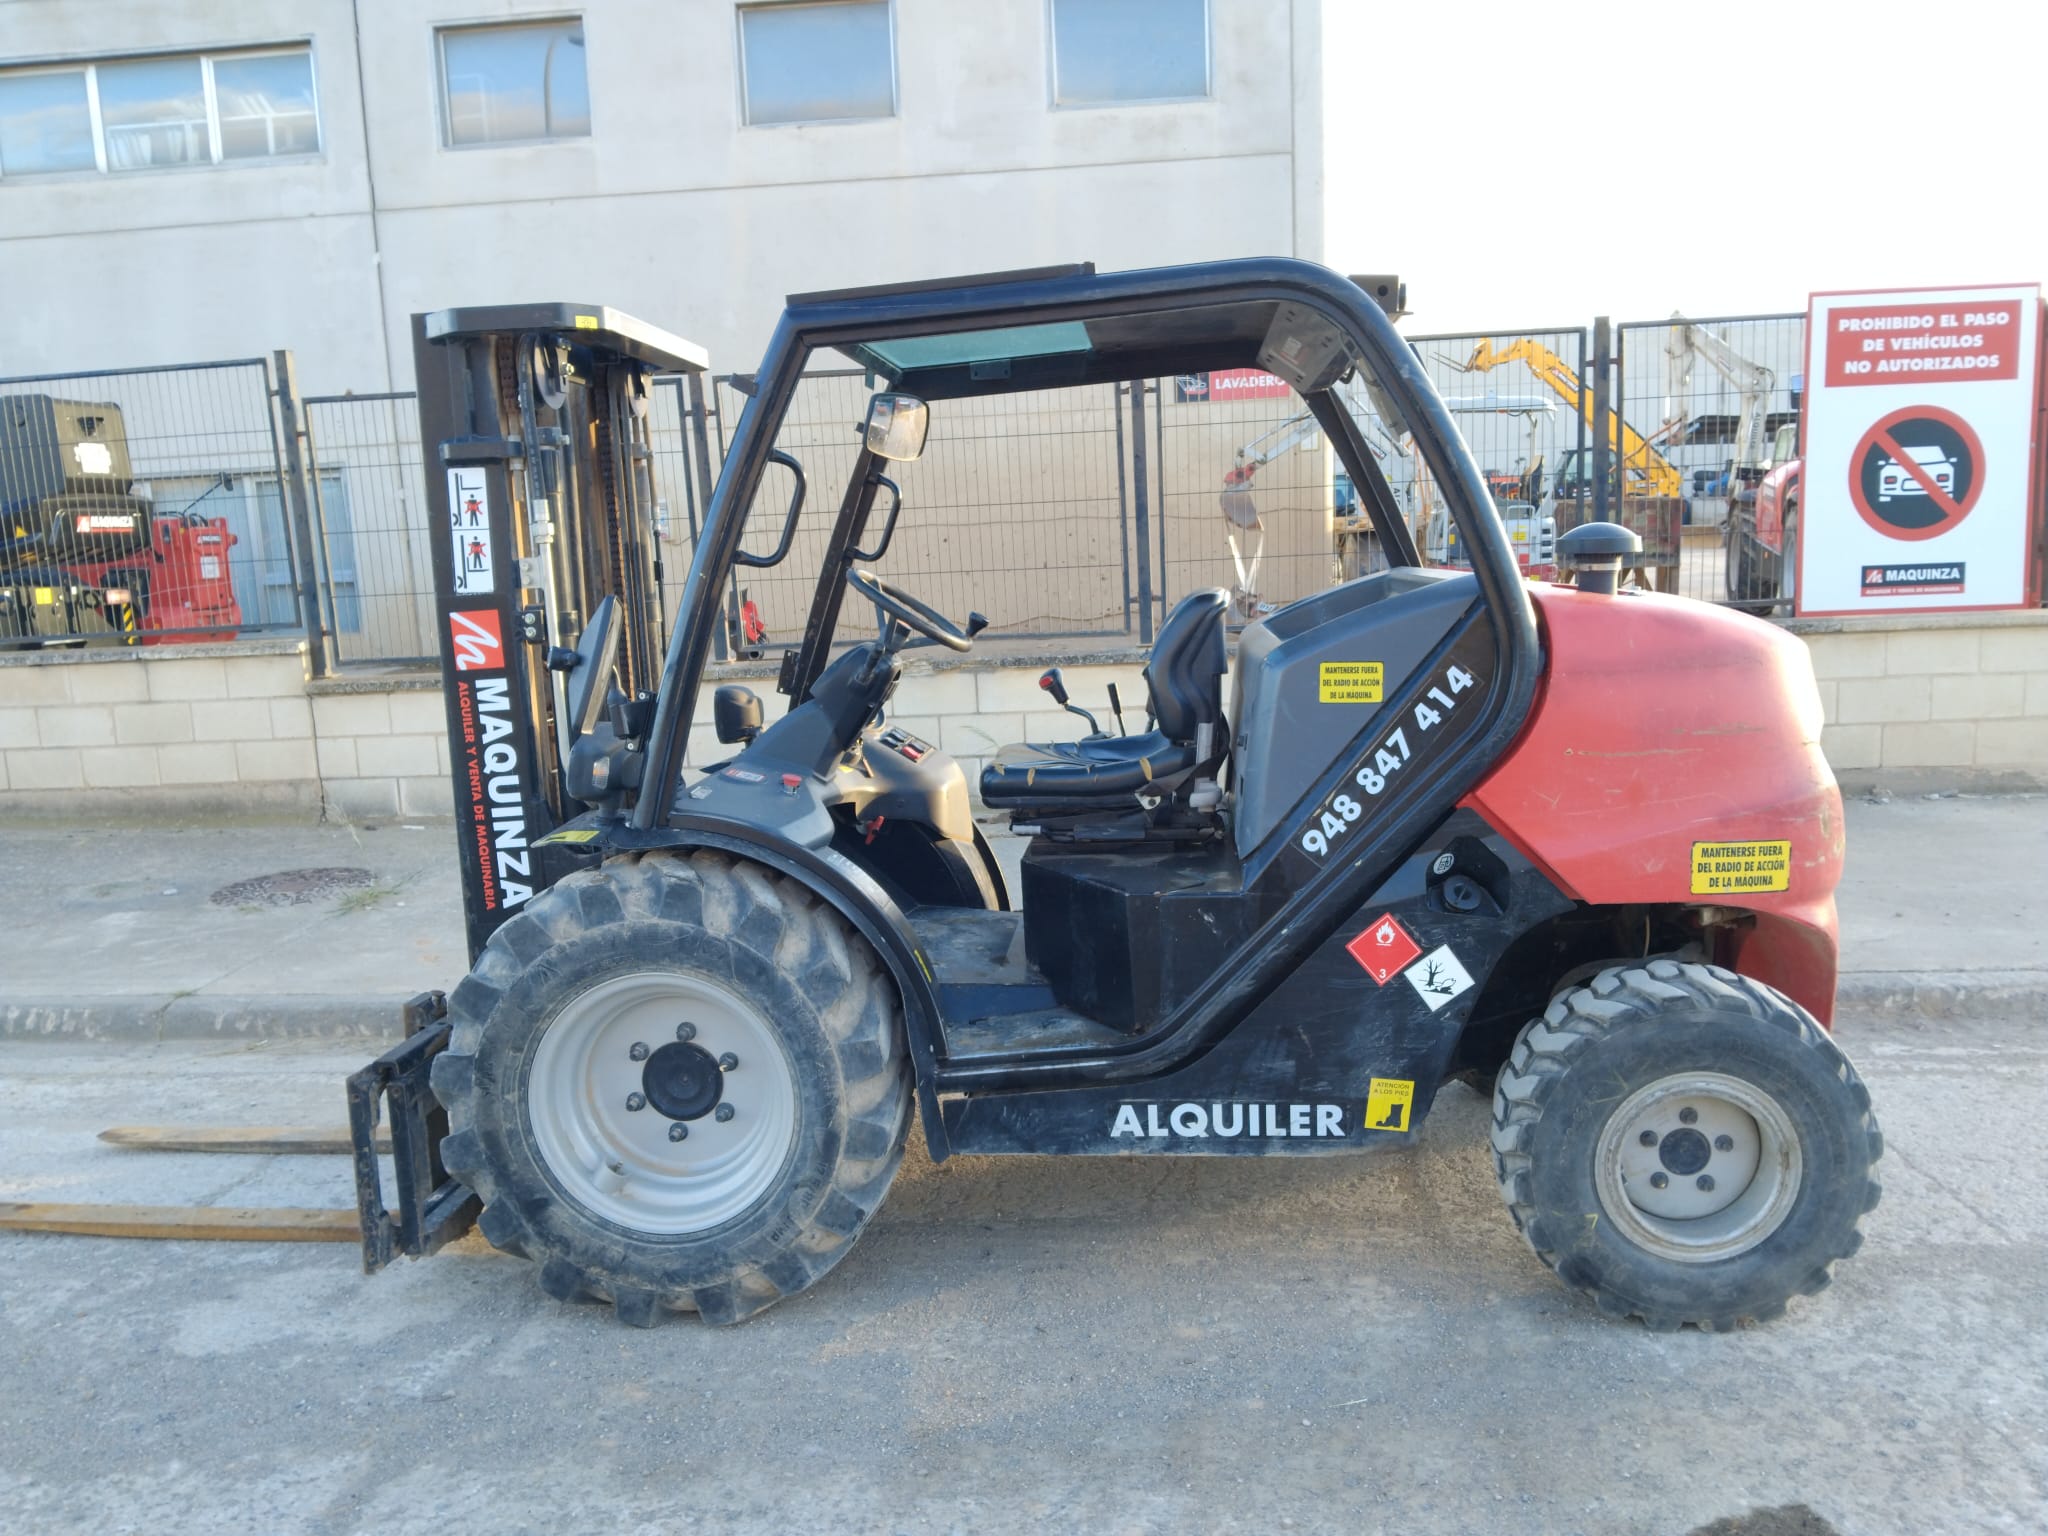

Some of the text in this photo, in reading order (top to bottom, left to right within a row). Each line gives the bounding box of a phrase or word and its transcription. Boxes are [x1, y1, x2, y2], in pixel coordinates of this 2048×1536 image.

[1839, 312, 2010, 331] PROHIBIDO EL PASO
[1863, 332, 1984, 352] DE VEHÍCULOS
[1844, 355, 2000, 374] NO AUTORIZADOS
[1885, 567, 1961, 582] MAQUINZA
[1325, 666, 1378, 674] MANTENERSE FUERA
[1322, 679, 1332, 687] DEL
[1333, 679, 1351, 687] RADIO
[1352, 679, 1359, 687] DE
[1330, 691, 1337, 699] DE
[1338, 691, 1345, 699] LA
[1302, 665, 1474, 857] 948 847 414
[457, 680, 496, 911] ALQUILER Y VENTA DE MAQUINARIA
[475, 677, 534, 910] MAQUINZA
[1701, 845, 1783, 858] MANTENERSE FUERA
[1697, 858, 1785, 873] DEL RADIO DE ACCIÓN
[1709, 877, 1719, 888] DE
[1722, 877, 1732, 887] LA
[1379, 968, 1386, 979] 3
[1110, 1102, 1346, 1138] ALQUILER
